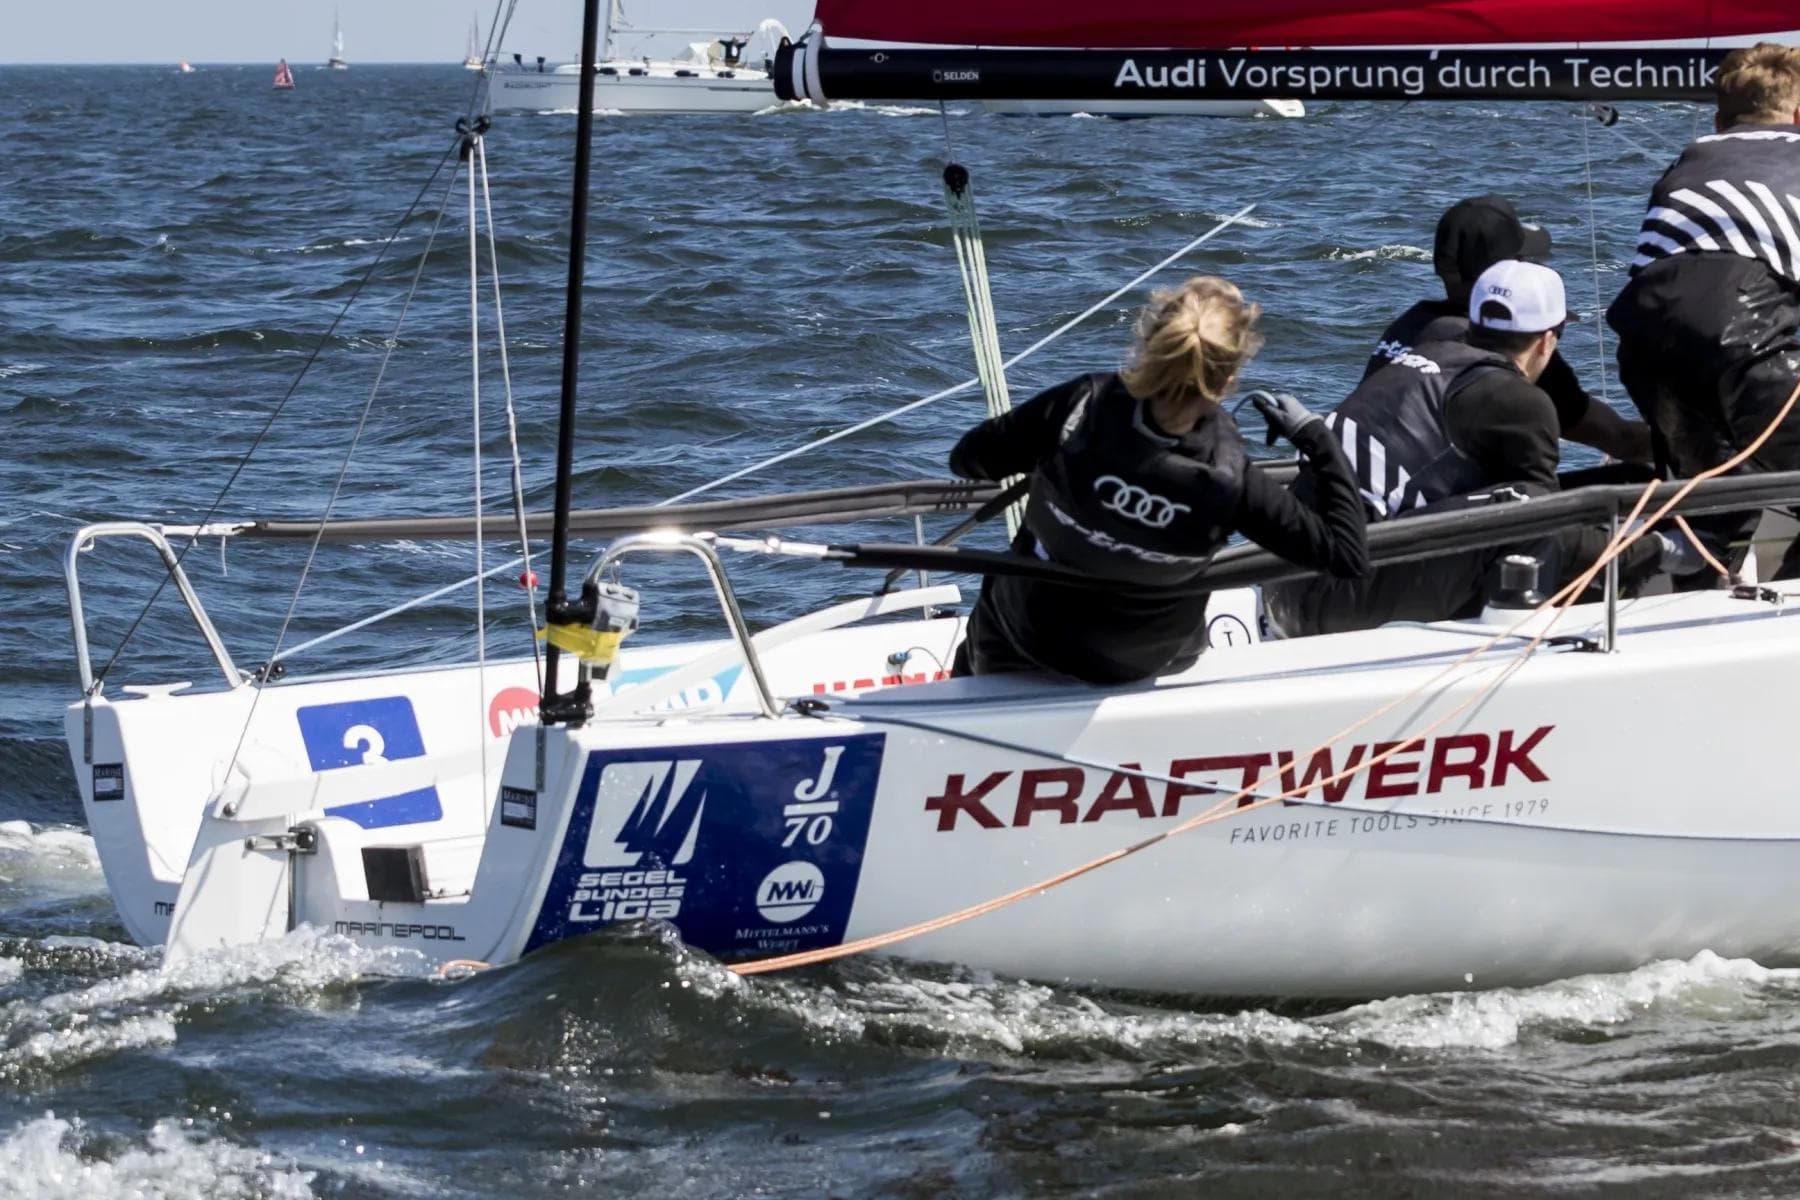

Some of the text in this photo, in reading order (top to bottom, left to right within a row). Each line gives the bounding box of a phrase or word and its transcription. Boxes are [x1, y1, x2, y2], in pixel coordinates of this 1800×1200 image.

[1114, 58, 1720, 94] Audi Vorsprung durch Technik
[794, 746, 846, 801] J
[924, 725, 1556, 831] KRAFTWERK
[782, 815, 833, 848] 70
[1231, 819, 1338, 845] FAVORITE
[1351, 812, 1419, 834] TOOLS
[1504, 798, 1550, 818] 1979
[573, 886, 684, 901] BUNDES
[577, 870, 688, 888] SEGEL
